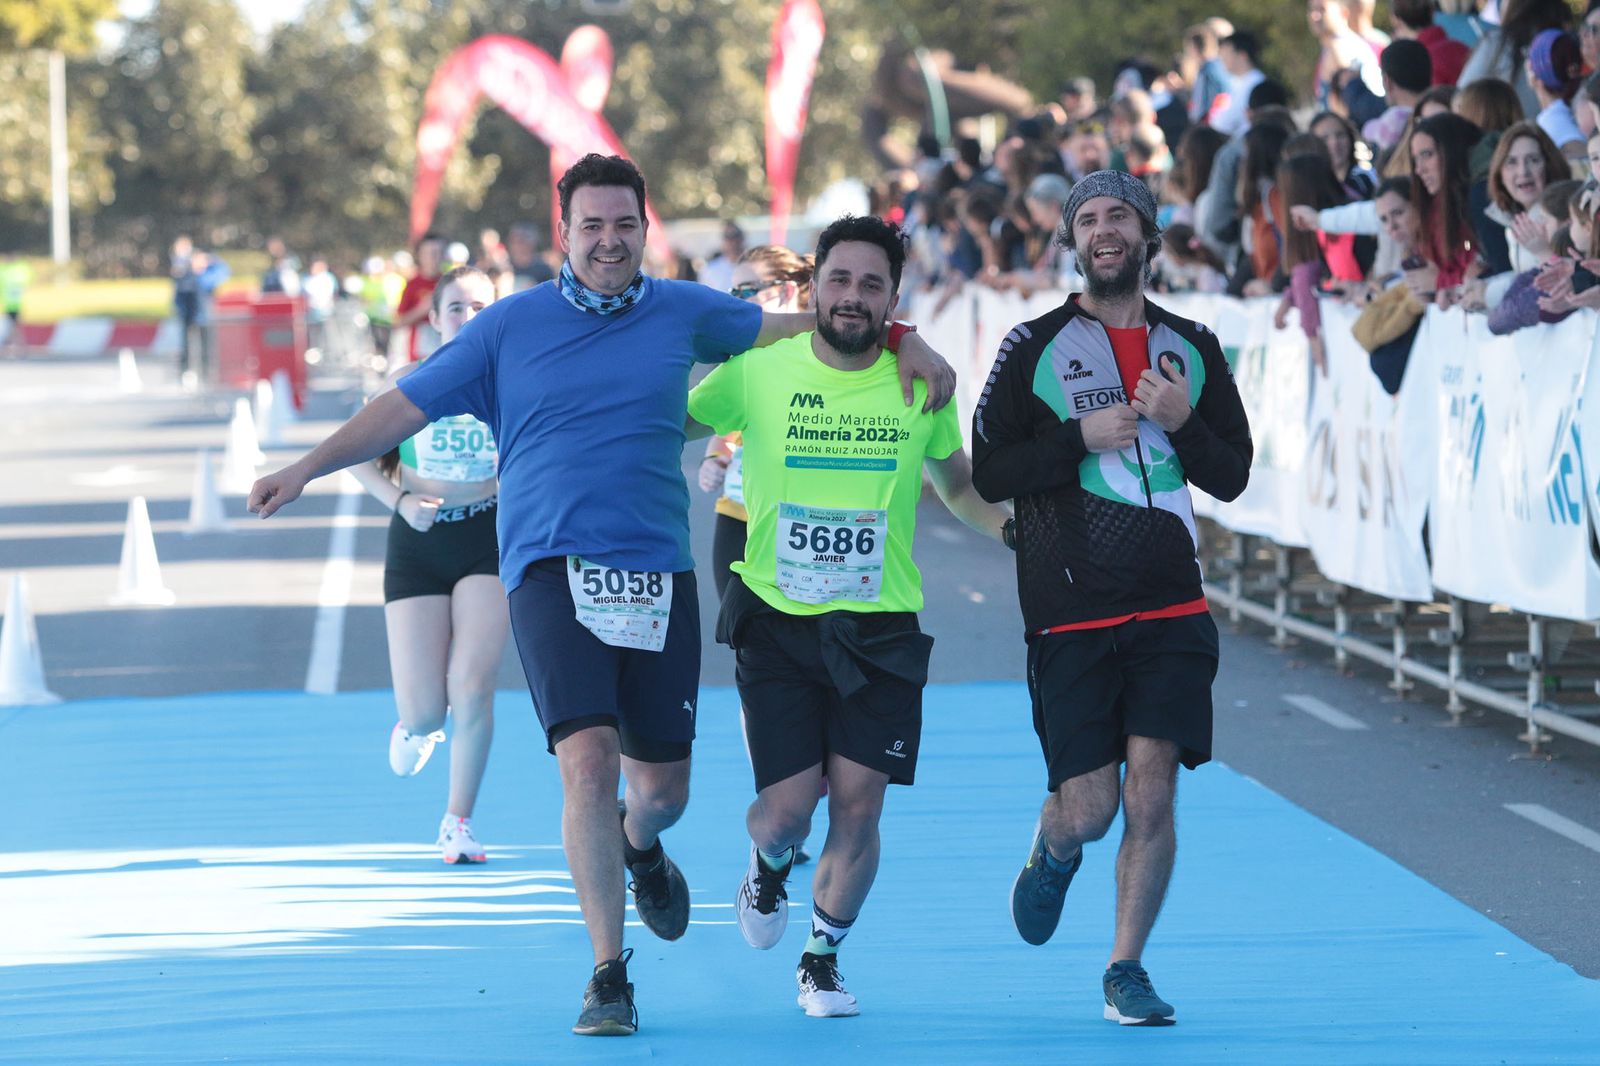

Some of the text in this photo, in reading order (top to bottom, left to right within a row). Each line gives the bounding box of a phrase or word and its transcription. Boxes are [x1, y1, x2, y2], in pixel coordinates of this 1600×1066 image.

[1063, 370, 1094, 382] VIATOR
[787, 411, 900, 426] Medio Maratón
[786, 425, 852, 442] Almería
[785, 444, 899, 456] RAMÓN RUIZ ANDÚJAR
[788, 522, 876, 556] 5686
[812, 554, 846, 563] JAVIER
[582, 568, 664, 598] 5058
[593, 596, 628, 604] MIGUEL
[630, 597, 655, 606] ANGEL
